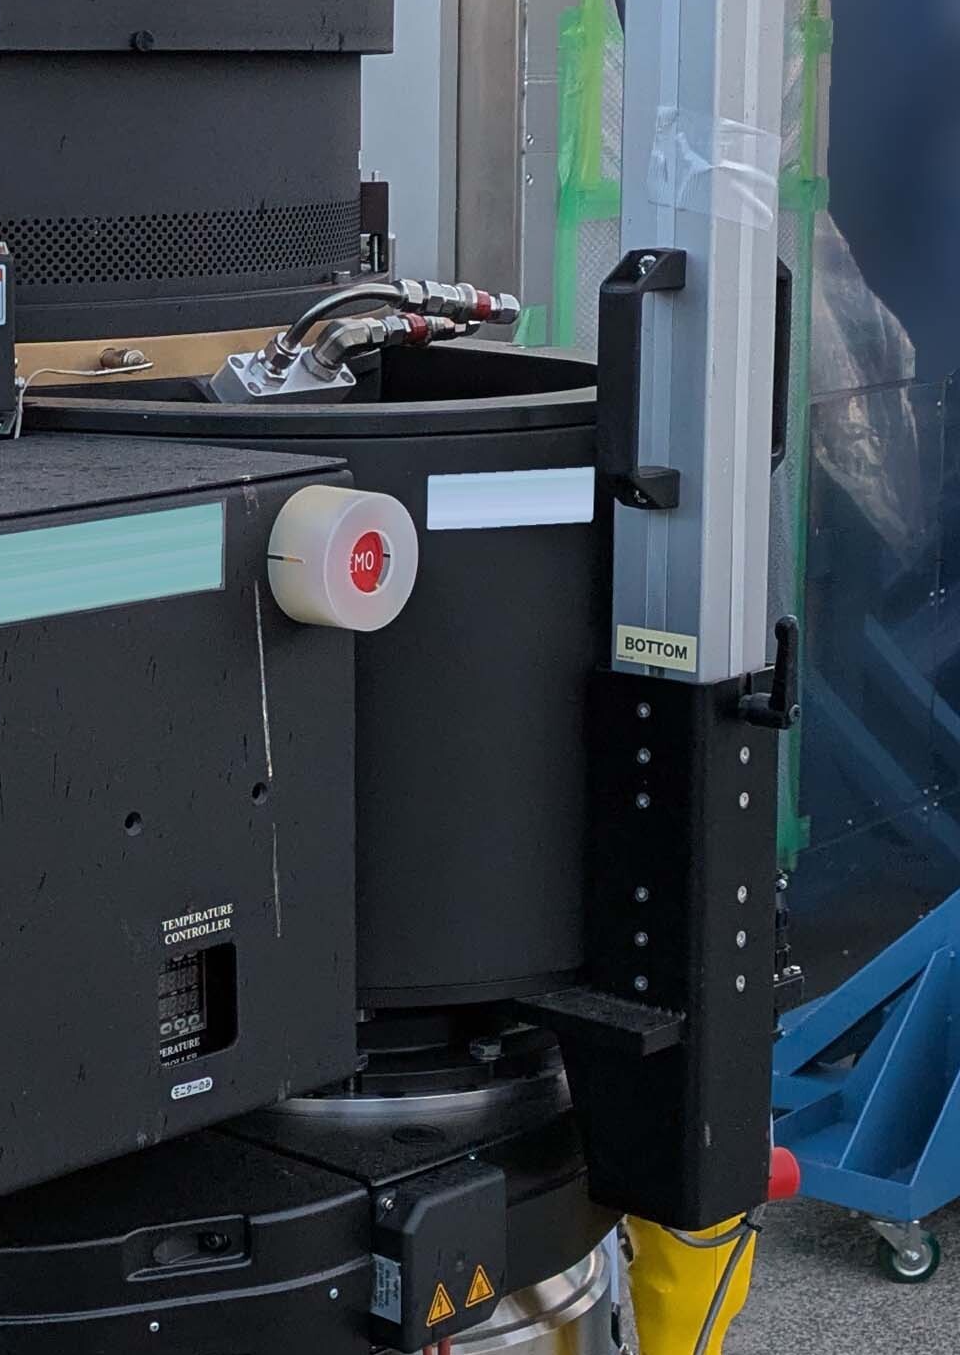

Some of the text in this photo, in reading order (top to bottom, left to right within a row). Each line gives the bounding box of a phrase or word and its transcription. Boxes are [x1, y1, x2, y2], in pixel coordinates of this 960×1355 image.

[625, 636, 688, 660] BOTTOM
[162, 903, 234, 932] TEMPERATURE
[164, 918, 231, 945] CONTROLLER
[160, 1037, 200, 1058] ERATURE
[173, 1078, 211, 1098] モニターのみ
